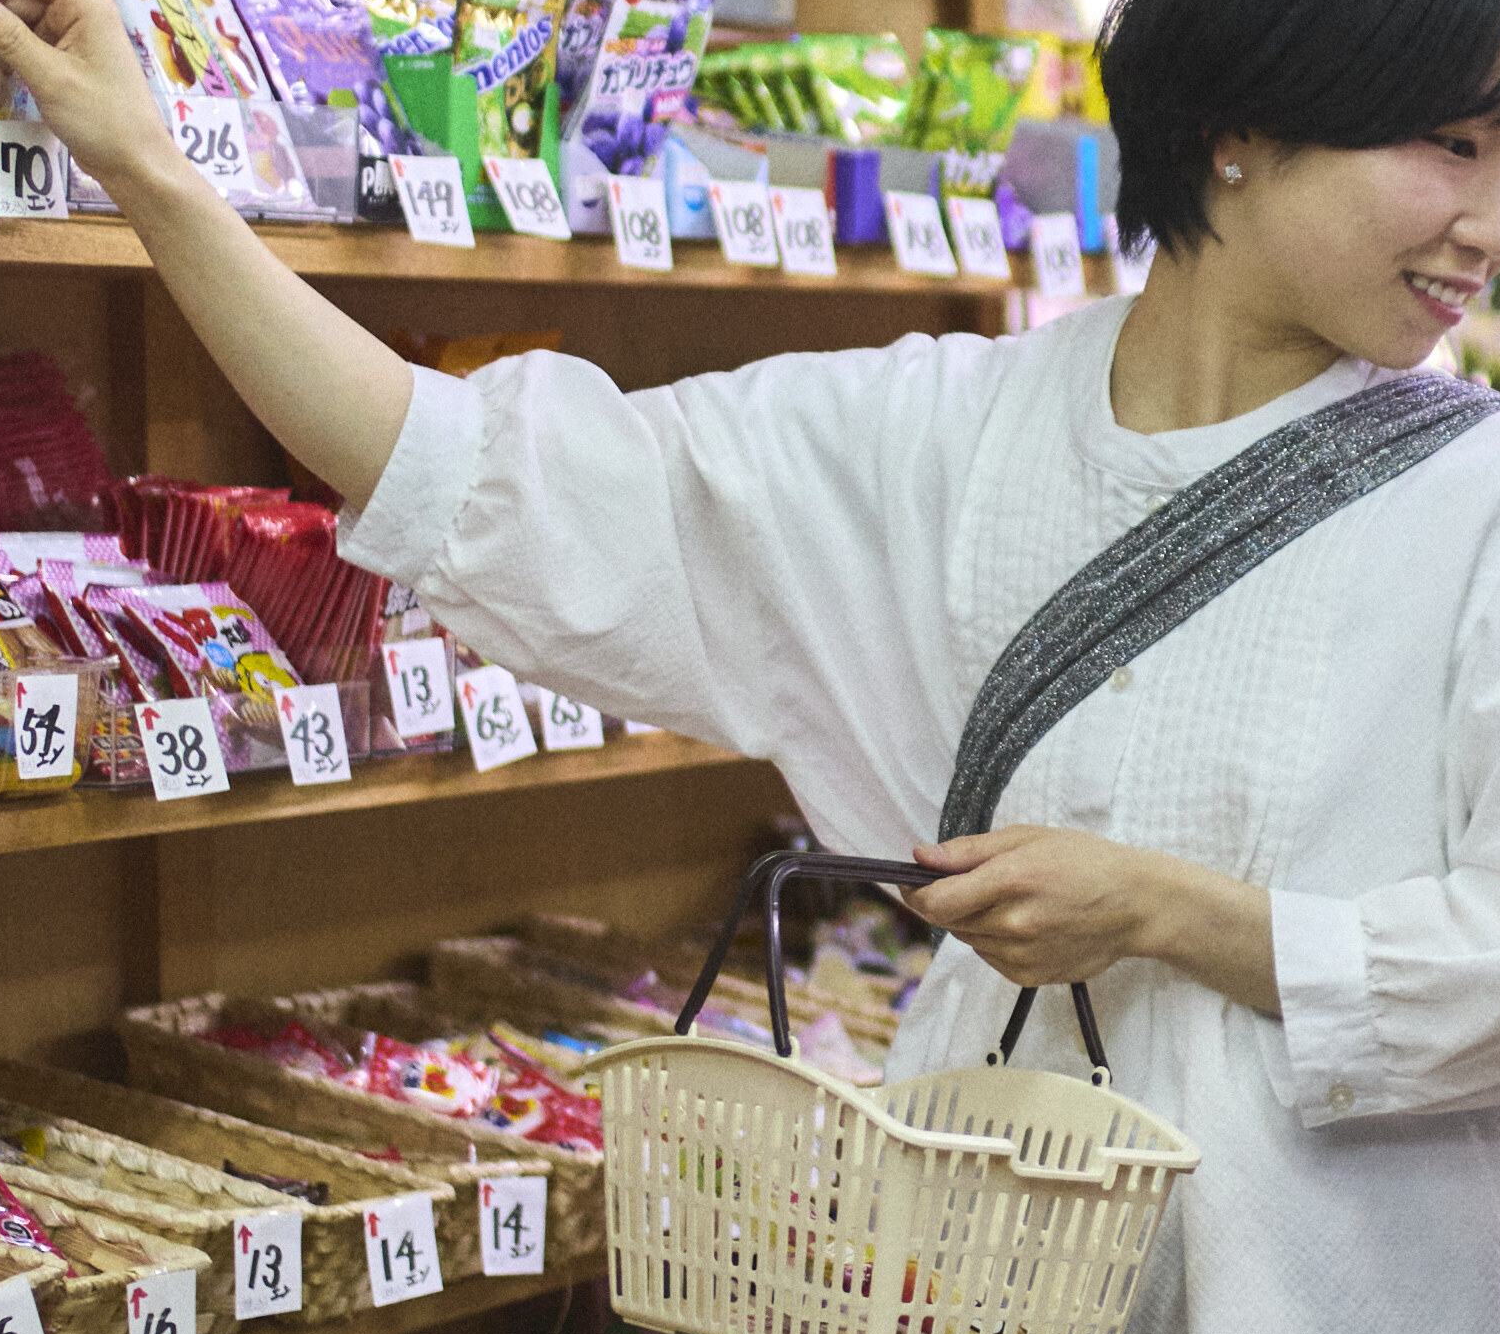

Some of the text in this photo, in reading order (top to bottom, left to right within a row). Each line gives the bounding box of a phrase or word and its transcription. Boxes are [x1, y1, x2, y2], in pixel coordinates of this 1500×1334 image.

[471, 17, 553, 90] mentos
[601, 55, 697, 94] ガブリチュウ
[179, 123, 239, 163] 216
[1, 141, 54, 211] 70 エン
[507, 183, 558, 213] 108
[618, 211, 662, 245] 108
[723, 205, 764, 238] 108
[785, 219, 823, 250] 108
[401, 667, 431, 707] 13
[292, 710, 334, 762] 43
[477, 695, 513, 741] 65
[157, 725, 212, 788] 38 エン
[493, 1203, 528, 1249] 14
[249, 1244, 282, 1288] 13
[381, 1230, 423, 1281] 14
